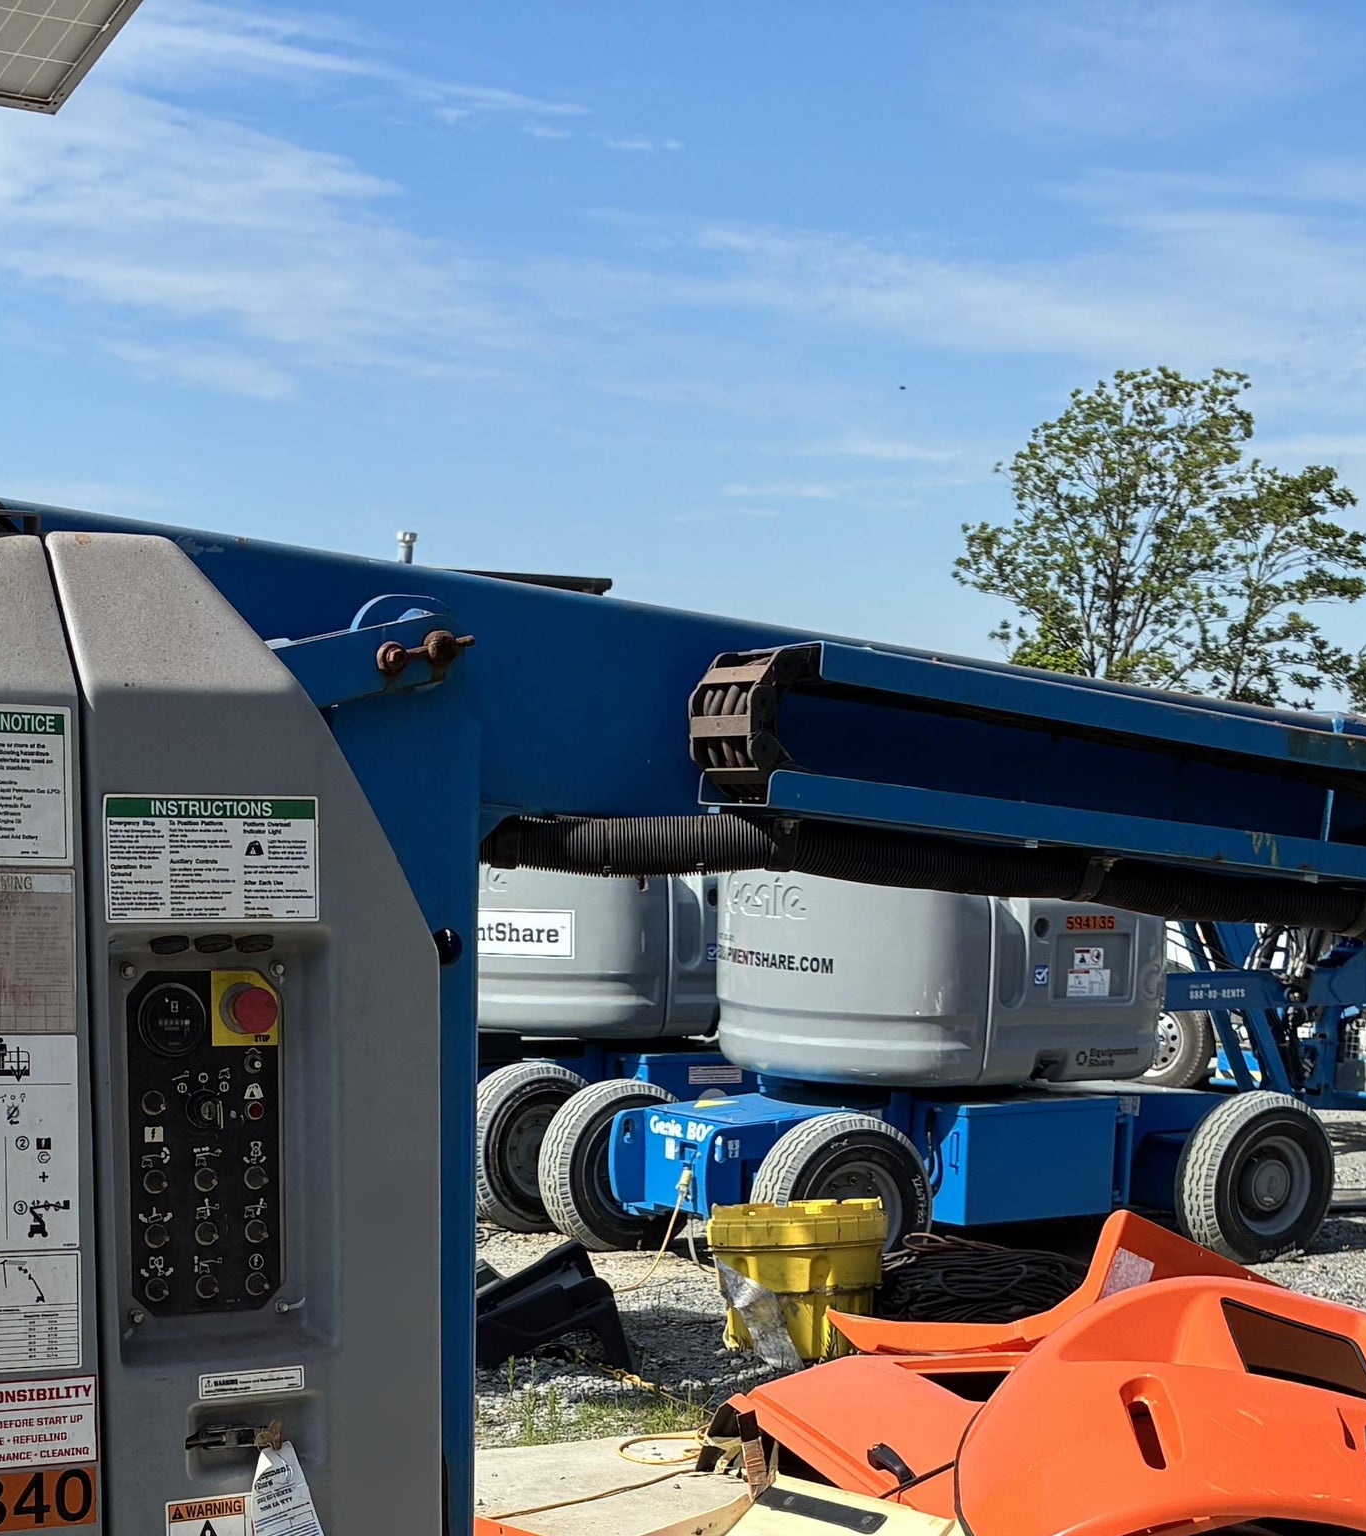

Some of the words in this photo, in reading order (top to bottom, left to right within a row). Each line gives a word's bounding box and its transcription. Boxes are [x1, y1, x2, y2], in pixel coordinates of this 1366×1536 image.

[0, 714, 55, 732] NOTICE
[151, 800, 273, 816] INSTRUCTIONS
[254, 1034, 271, 1042] STOP
[649, 1115, 683, 1138] Genie
[36, 1415, 68, 1427] START
[70, 1414, 83, 1424] UP
[13, 1432, 67, 1444] REFUELING
[40, 1447, 89, 1459] CLEANING
[186, 1501, 243, 1518] WARNING
